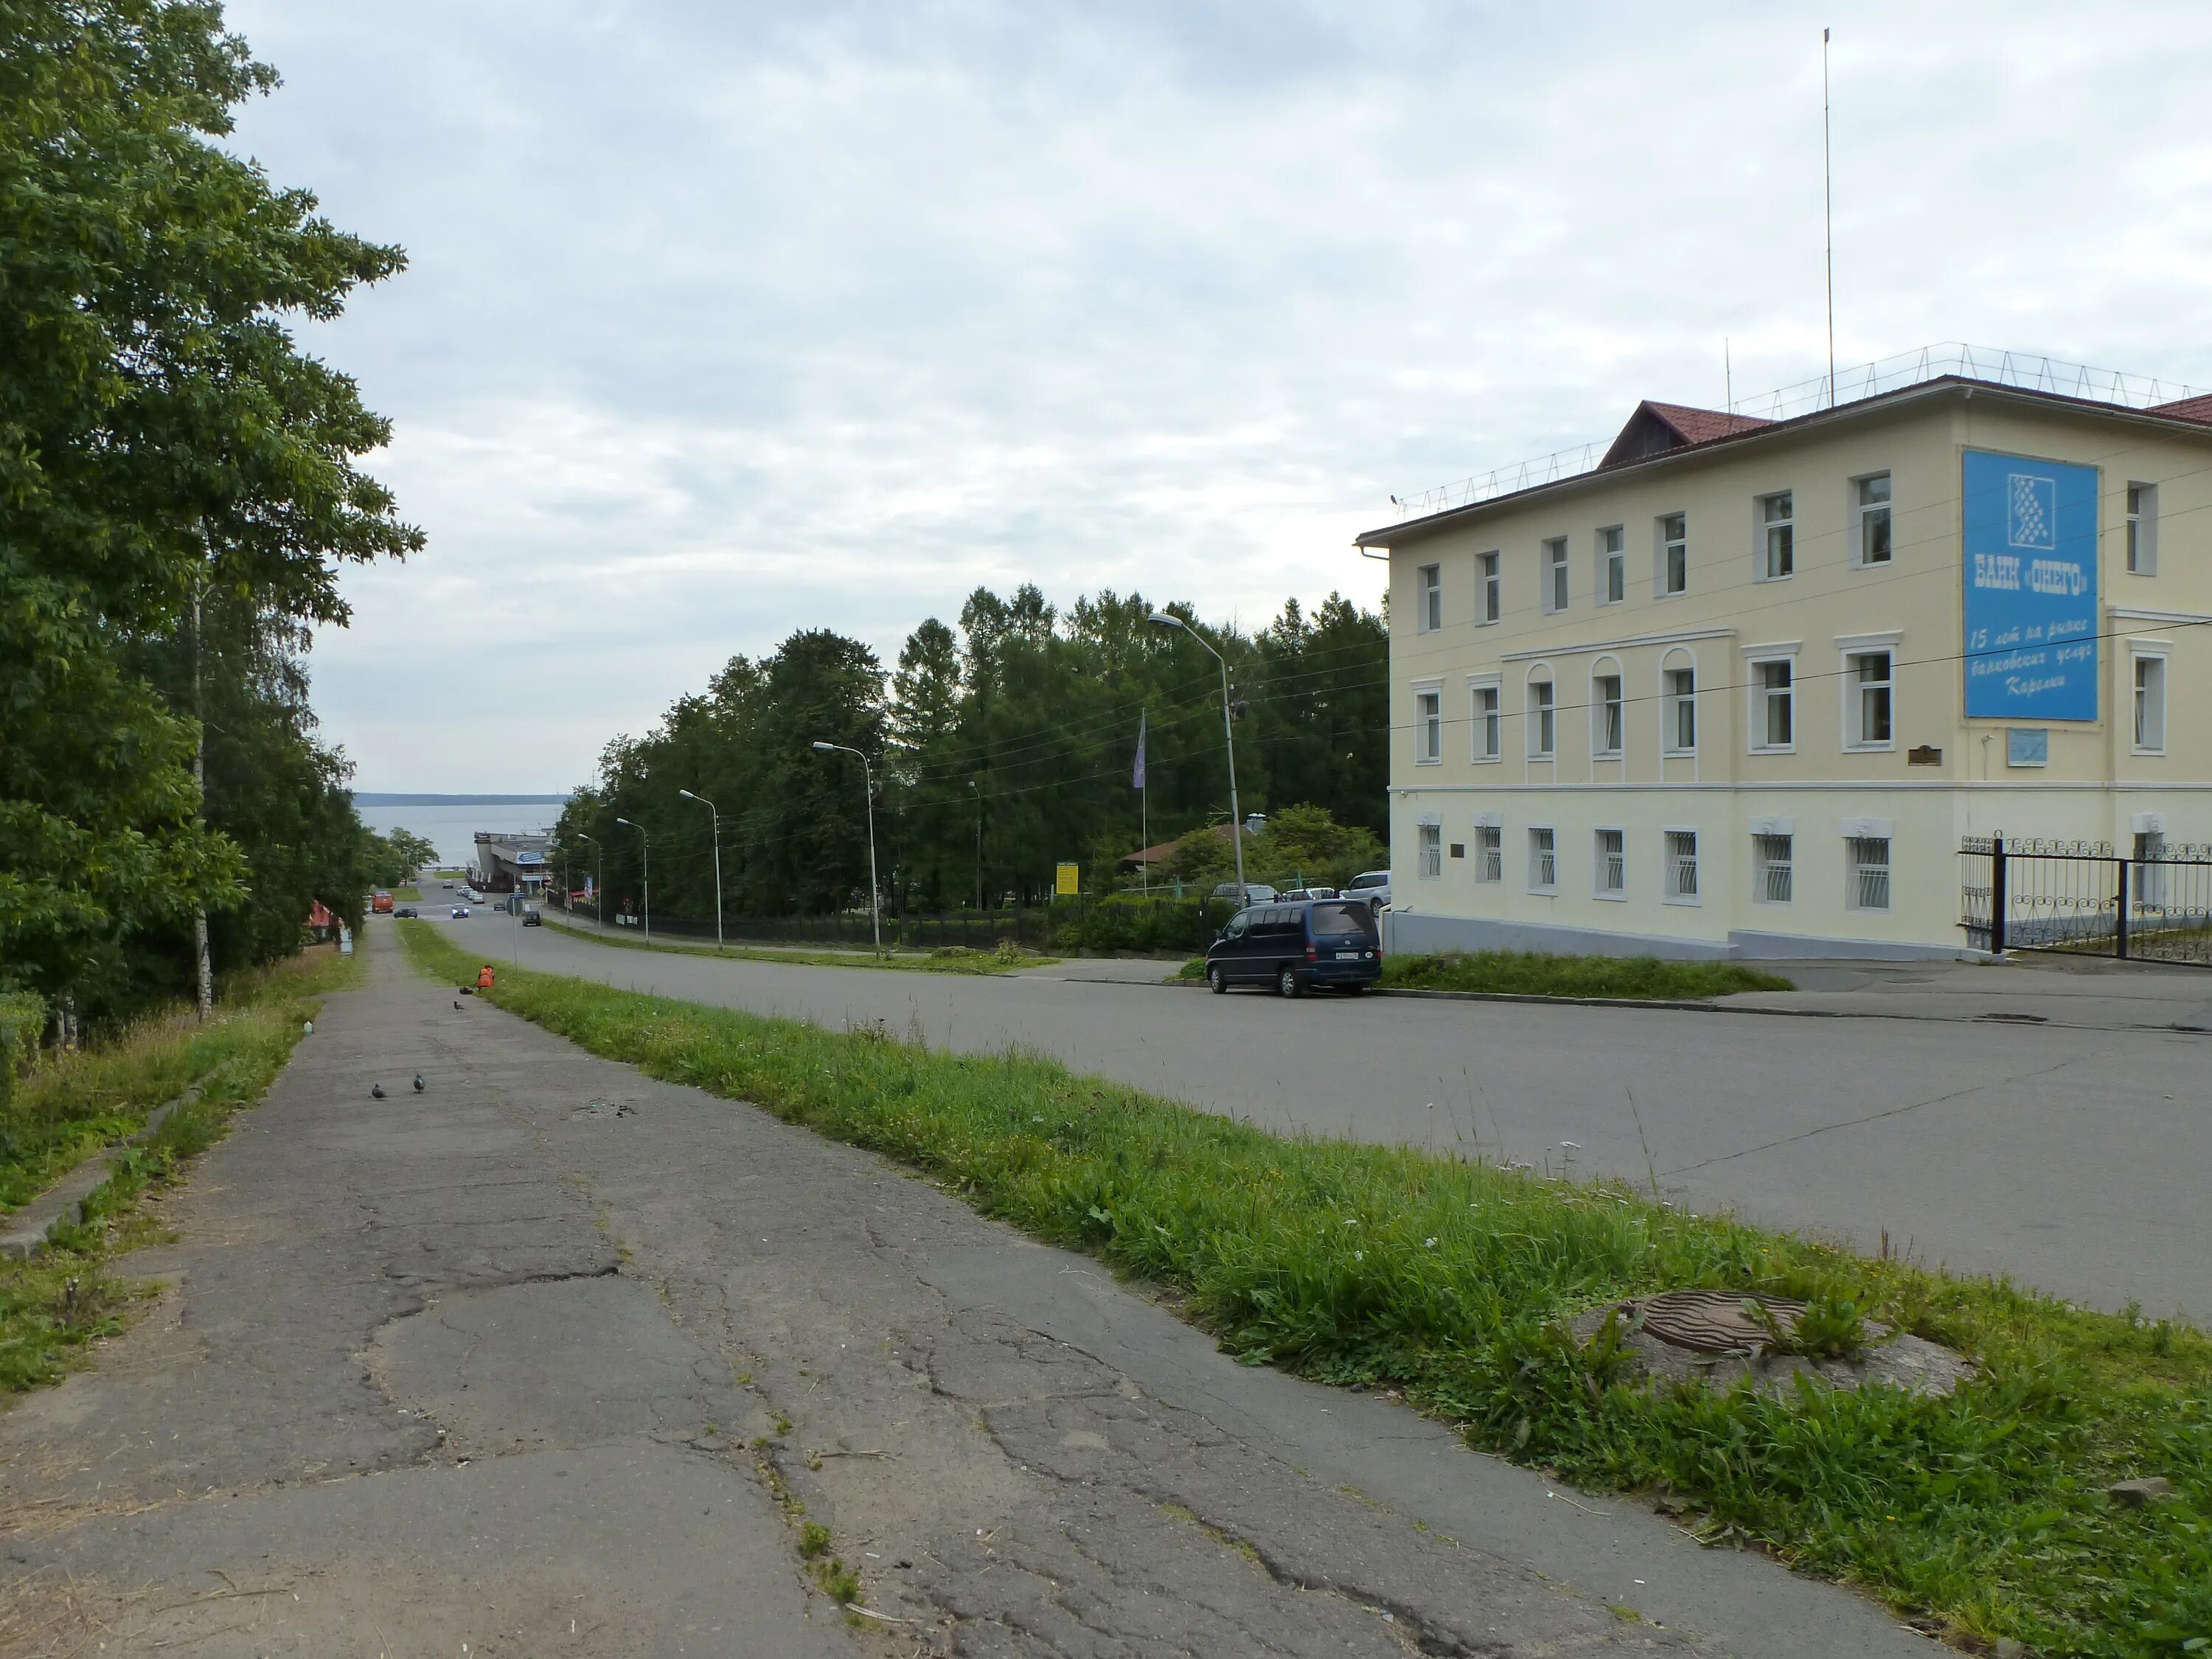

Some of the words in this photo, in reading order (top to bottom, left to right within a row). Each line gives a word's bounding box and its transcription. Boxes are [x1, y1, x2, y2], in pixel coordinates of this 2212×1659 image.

[1975, 554, 2020, 590] БАНК
[1971, 628, 1988, 649] 15
[1994, 627, 2020, 645] лет
[2025, 626, 2042, 641] на
[2047, 619, 2087, 641] рынке
[1971, 650, 2045, 677] банковских
[2056, 645, 2093, 665] услуг
[2005, 675, 2065, 698] Карелии
